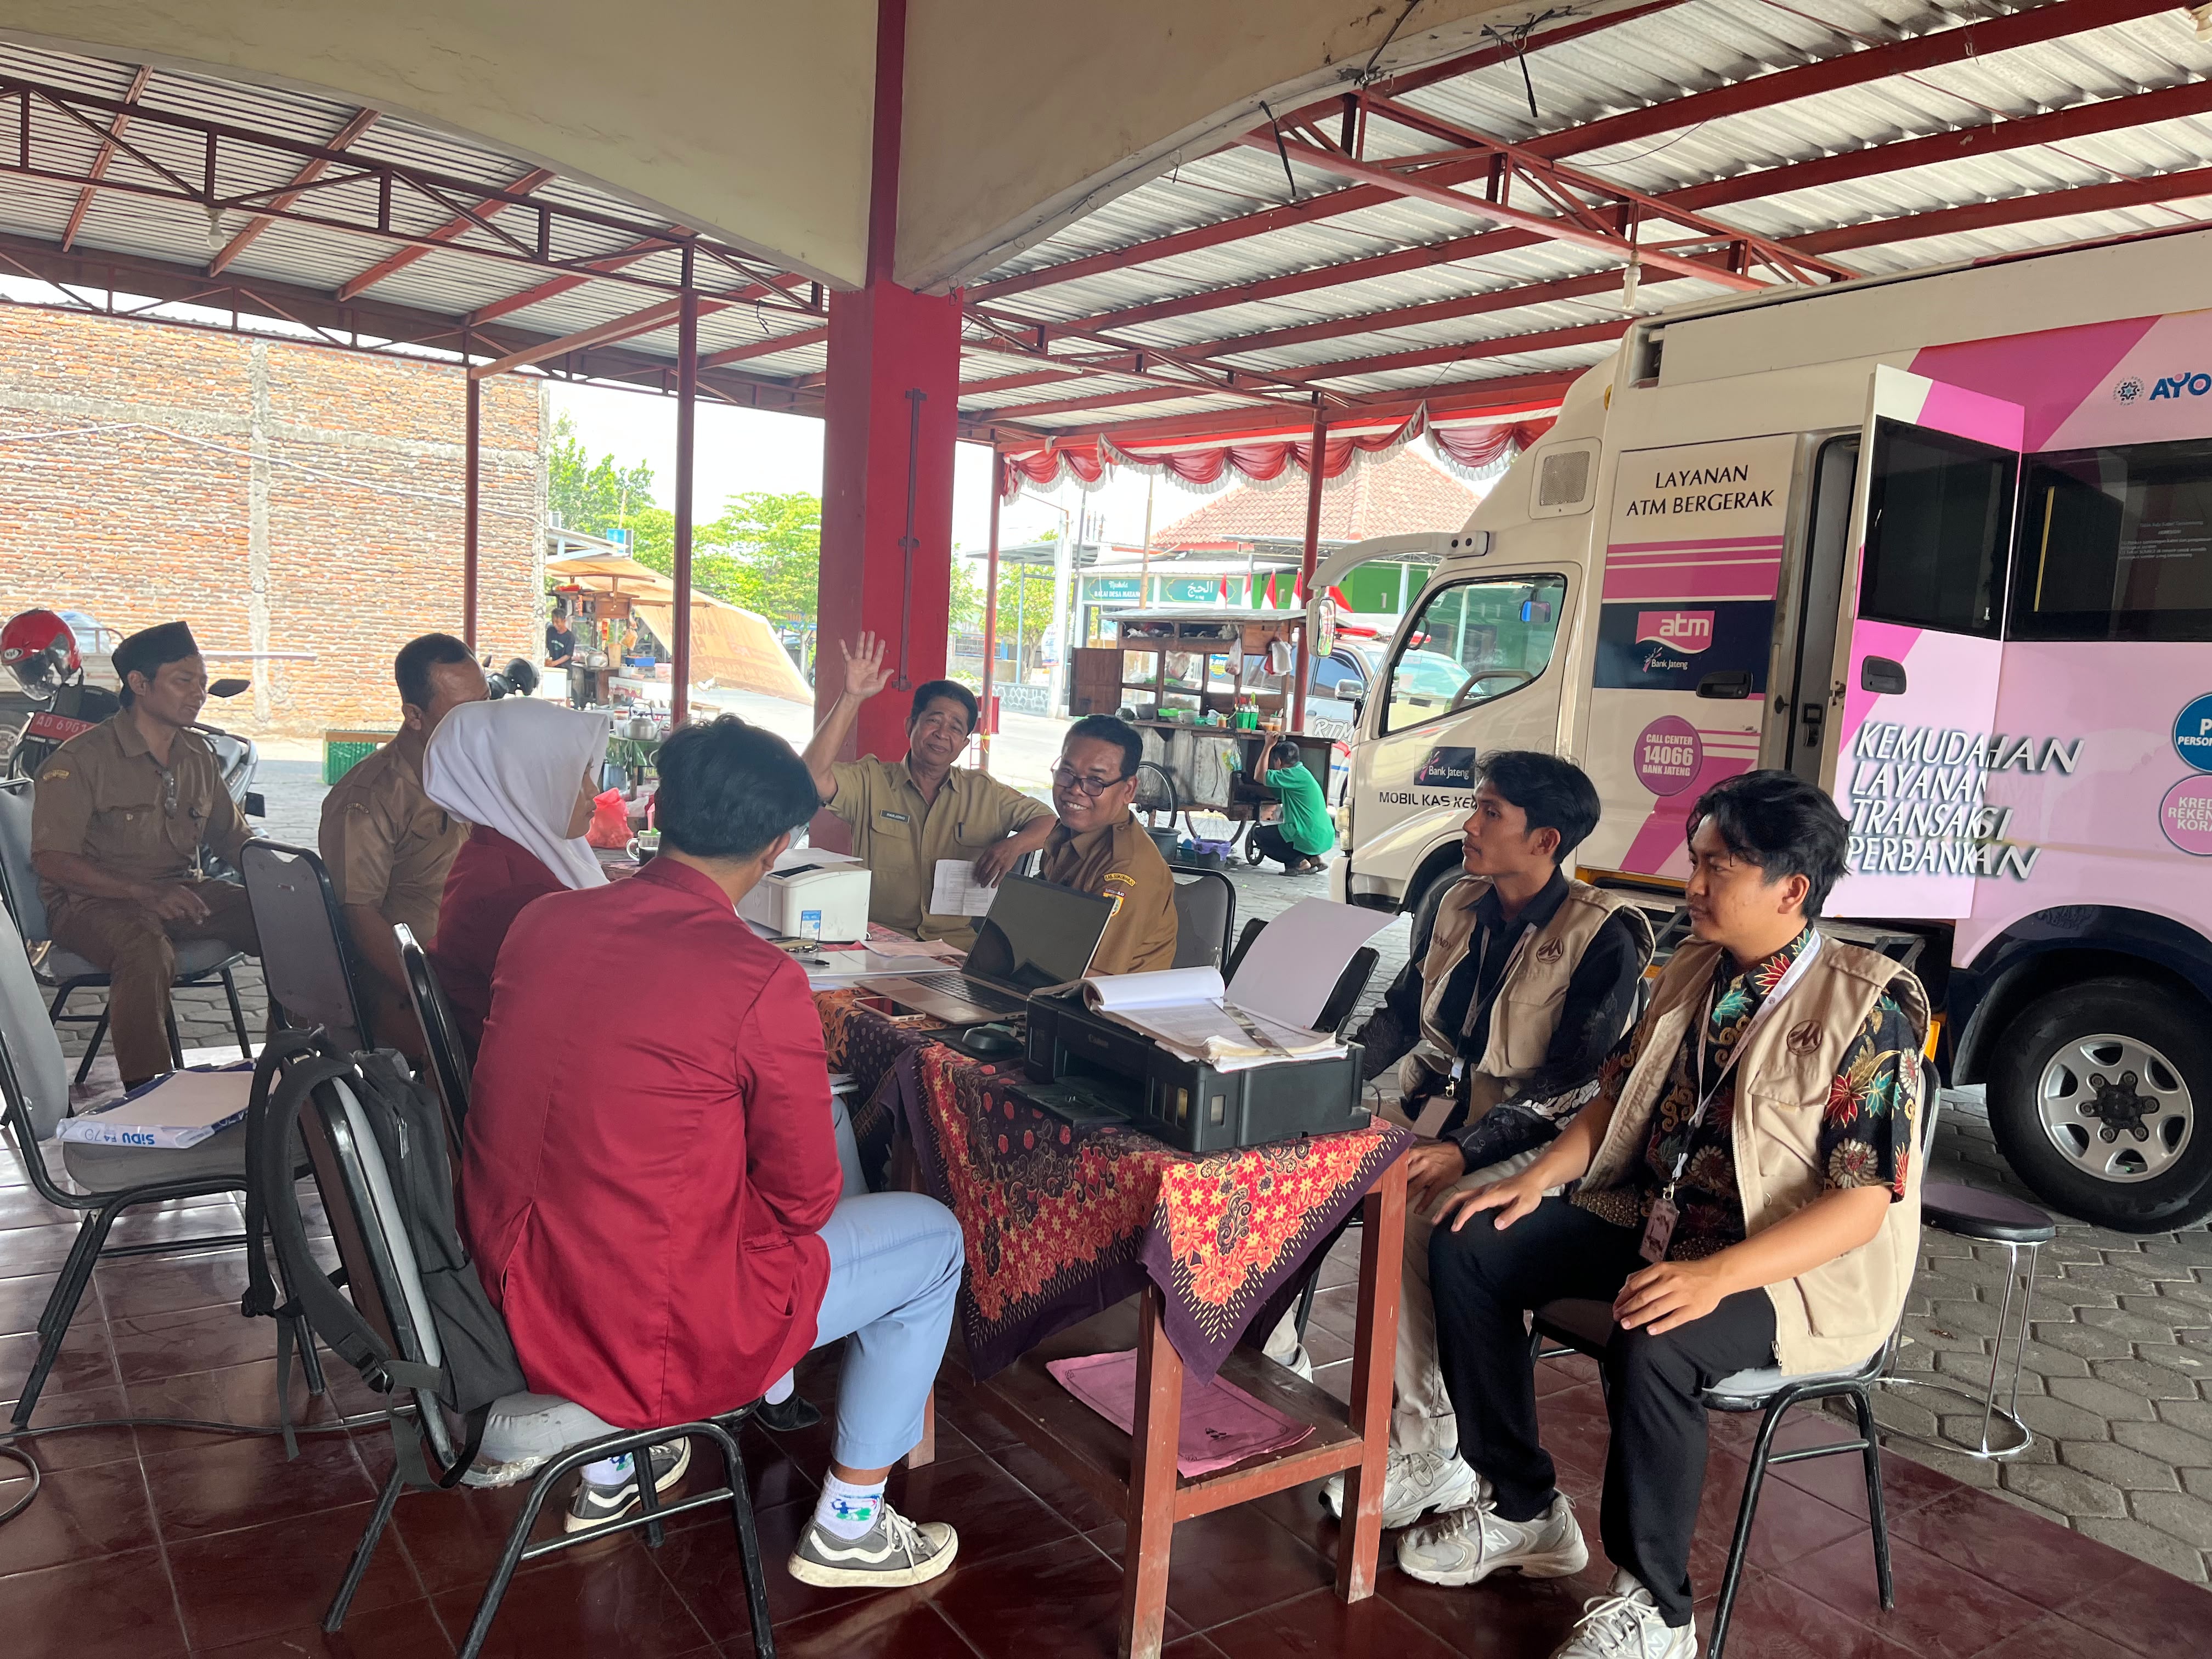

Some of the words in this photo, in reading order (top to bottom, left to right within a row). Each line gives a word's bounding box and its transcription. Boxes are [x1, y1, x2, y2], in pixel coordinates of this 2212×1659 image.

[2149, 372, 2212, 401] AYO
[1656, 465, 1749, 489] LAYANAN
[1626, 496, 1667, 517] ATM
[1673, 489, 1774, 514] BERGERAK
[1660, 613, 1709, 637] atm
[1651, 659, 1667, 669] Bank
[1668, 659, 1688, 670] Jateng
[36, 715, 53, 727] AD
[1646, 735, 1664, 746] CALL
[1666, 734, 1693, 746] CENTER
[1856, 722, 2084, 774] KEMUDAHAN
[1643, 747, 1694, 767] 14066
[1429, 765, 1446, 776] Bank
[1446, 766, 1469, 780] Jateng
[1643, 765, 1661, 776] BANK
[1663, 766, 1691, 777] JATENG
[1379, 792, 1418, 805] MOBIL
[1422, 794, 1450, 806] KAS
[1850, 798, 2014, 841] TRANSAKSI
[1847, 836, 2041, 879] PERBANKAN
